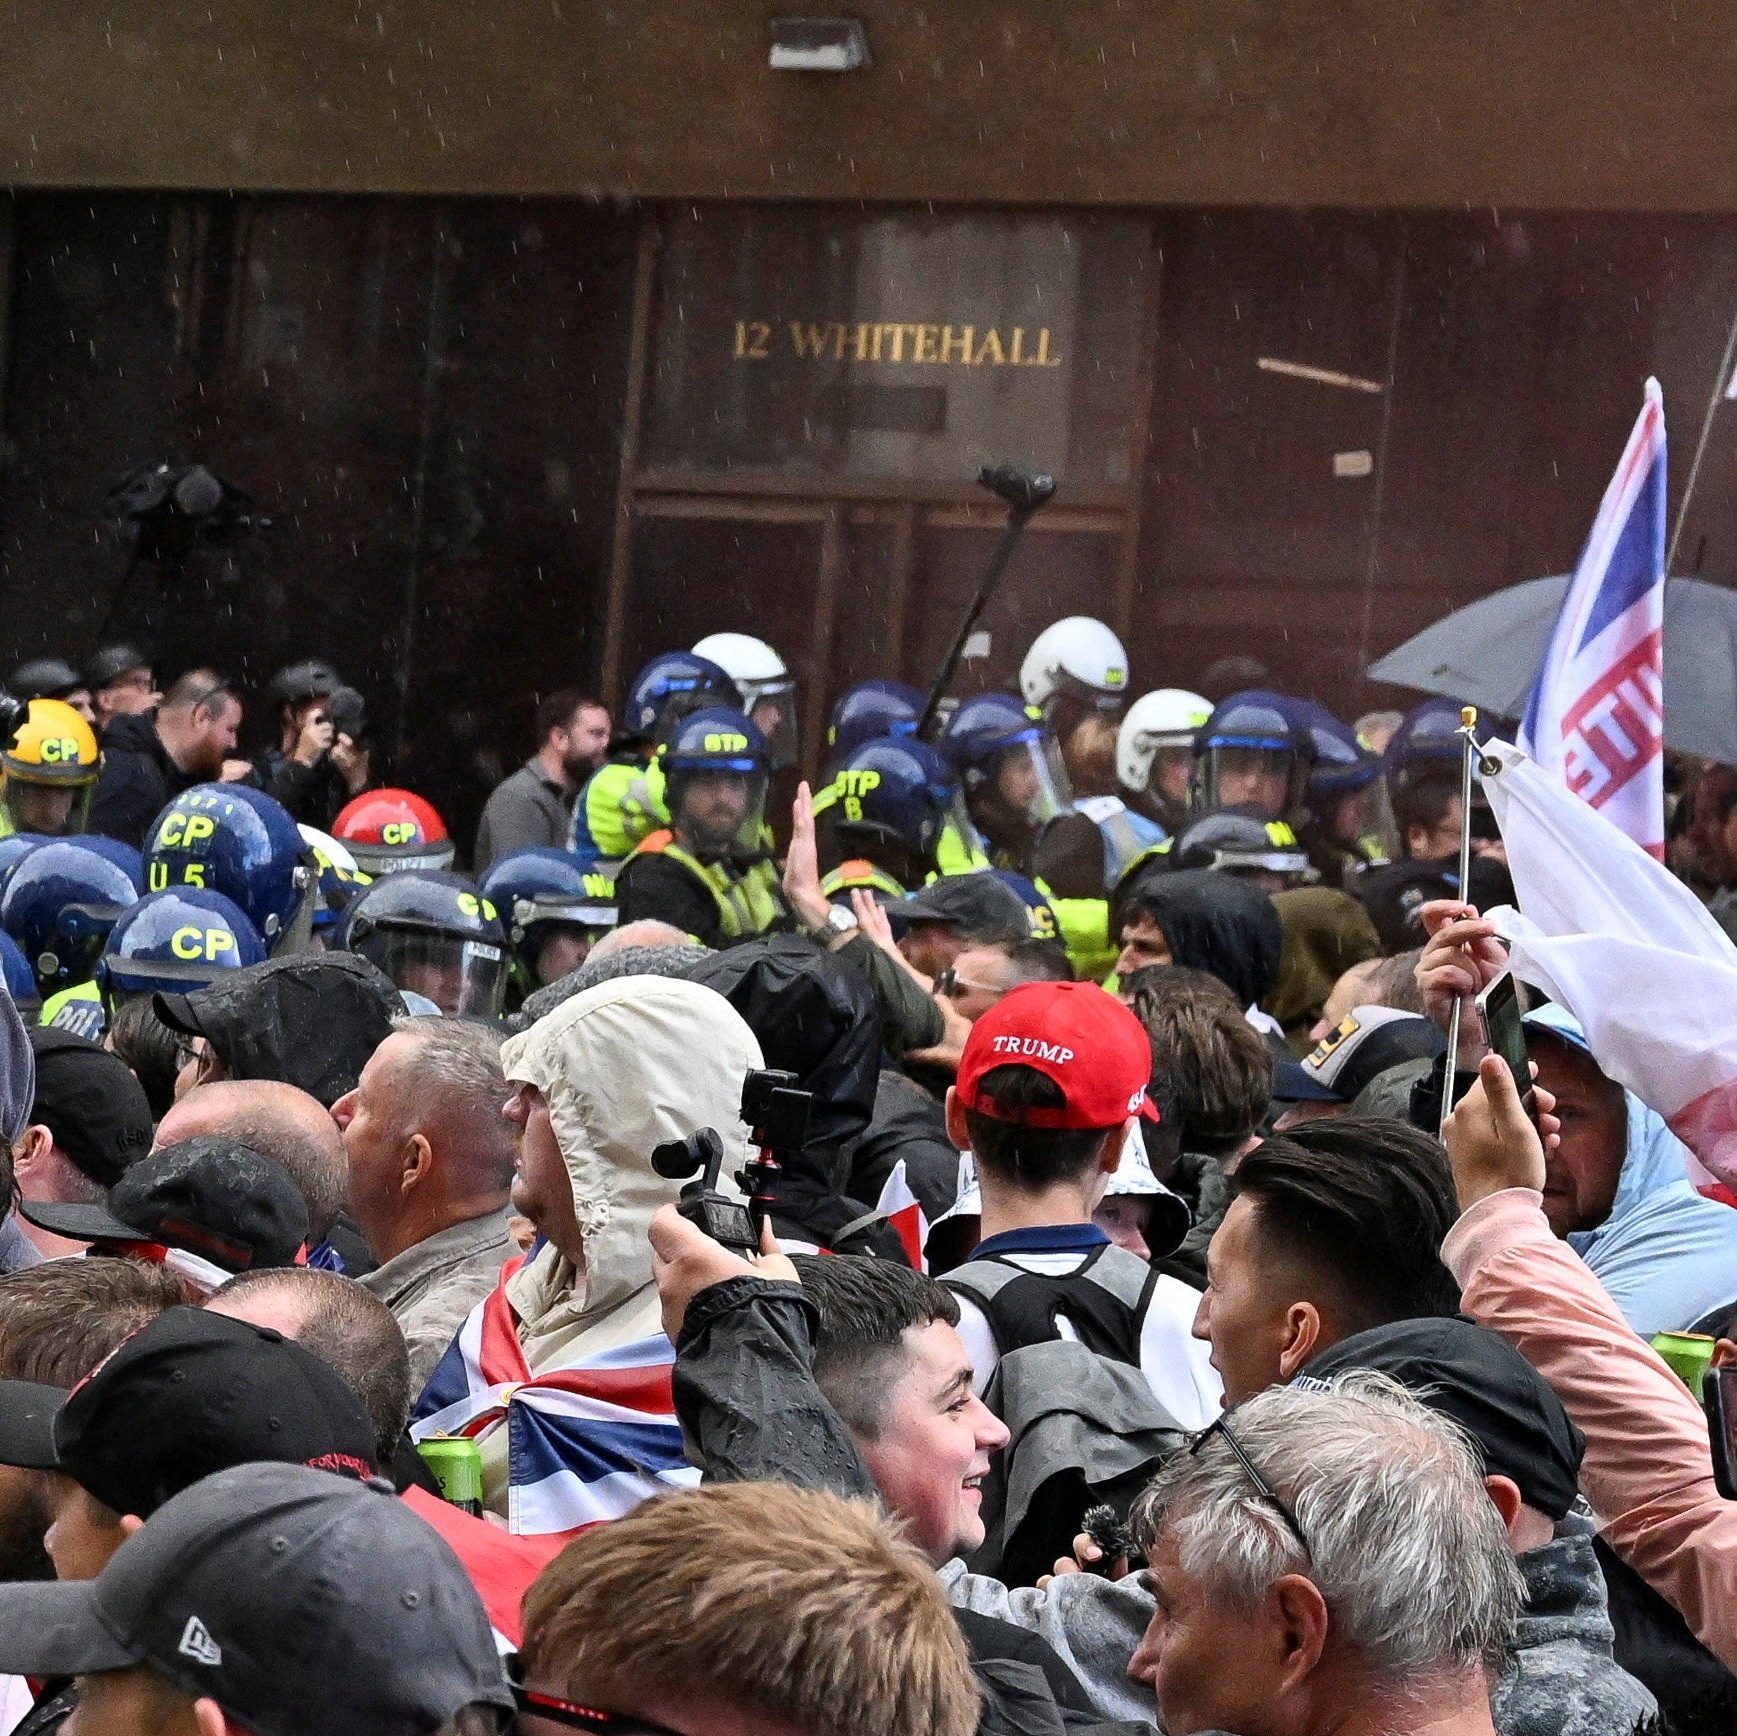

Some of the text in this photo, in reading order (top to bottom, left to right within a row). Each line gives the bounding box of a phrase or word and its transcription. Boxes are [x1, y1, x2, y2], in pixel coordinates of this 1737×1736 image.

[733, 322, 1062, 367] 12 WHITEHALL
[40, 738, 79, 762] CP
[157, 813, 204, 847] CP
[380, 822, 416, 845] CP
[149, 861, 167, 893] U
[170, 926, 231, 961] CP
[993, 1035, 1075, 1066] TRUMP
